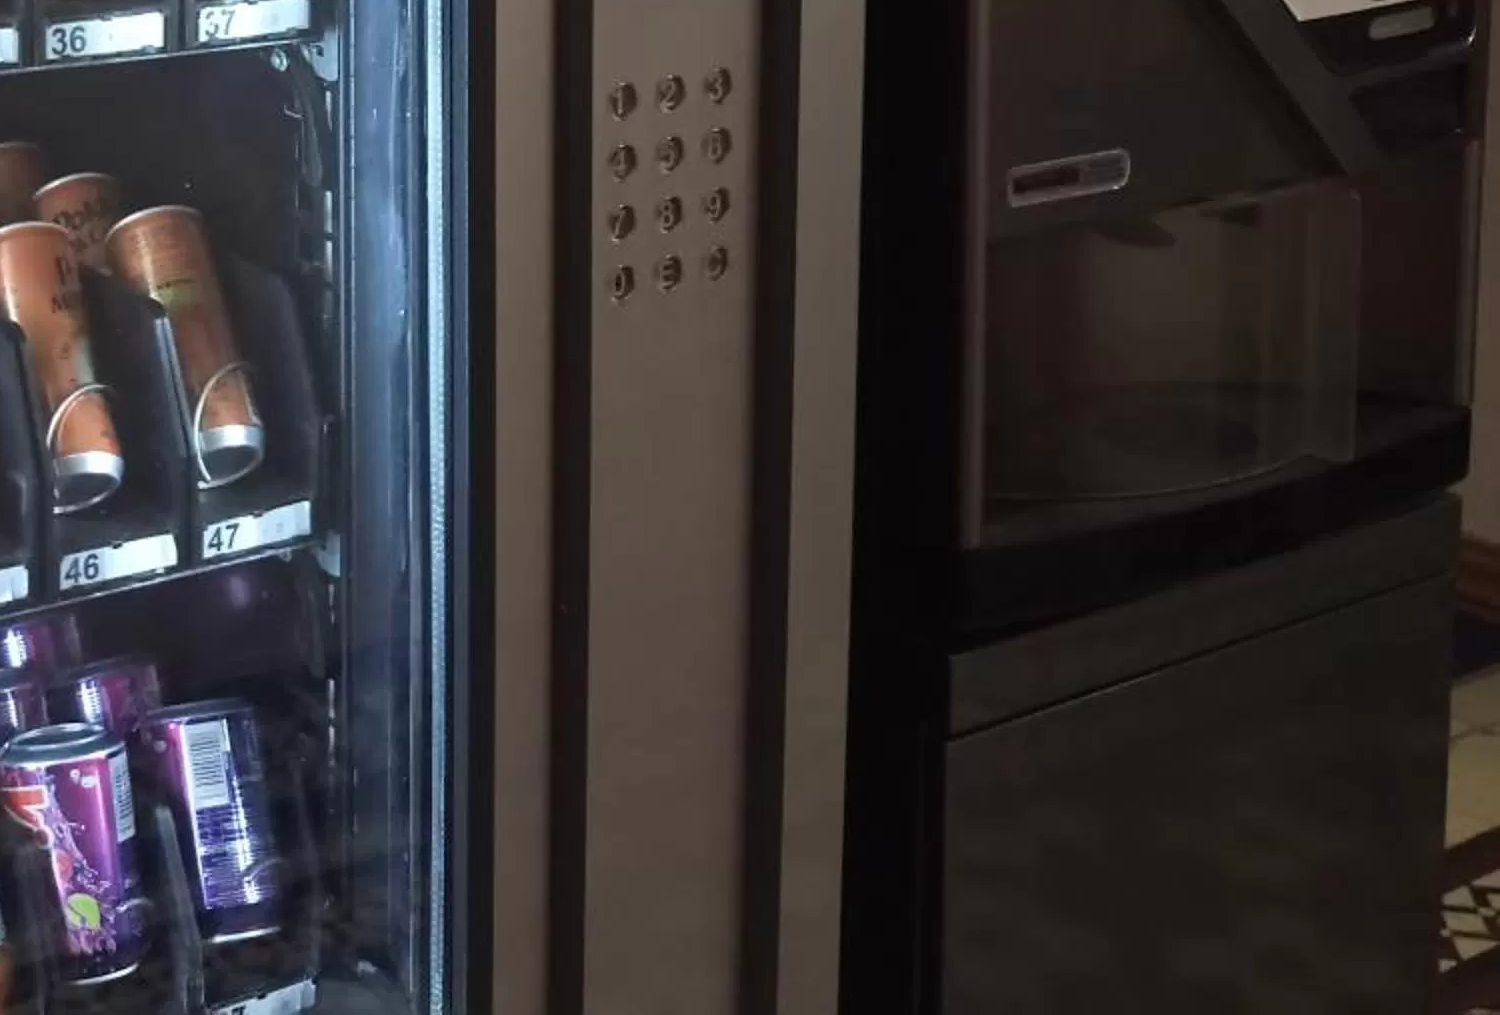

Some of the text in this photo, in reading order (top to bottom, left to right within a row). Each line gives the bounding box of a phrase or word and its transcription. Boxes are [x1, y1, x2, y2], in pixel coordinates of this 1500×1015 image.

[205, 9, 235, 37] 37
[52, 26, 88, 56] 36
[206, 523, 241, 552] 47
[64, 553, 100, 583] 46
